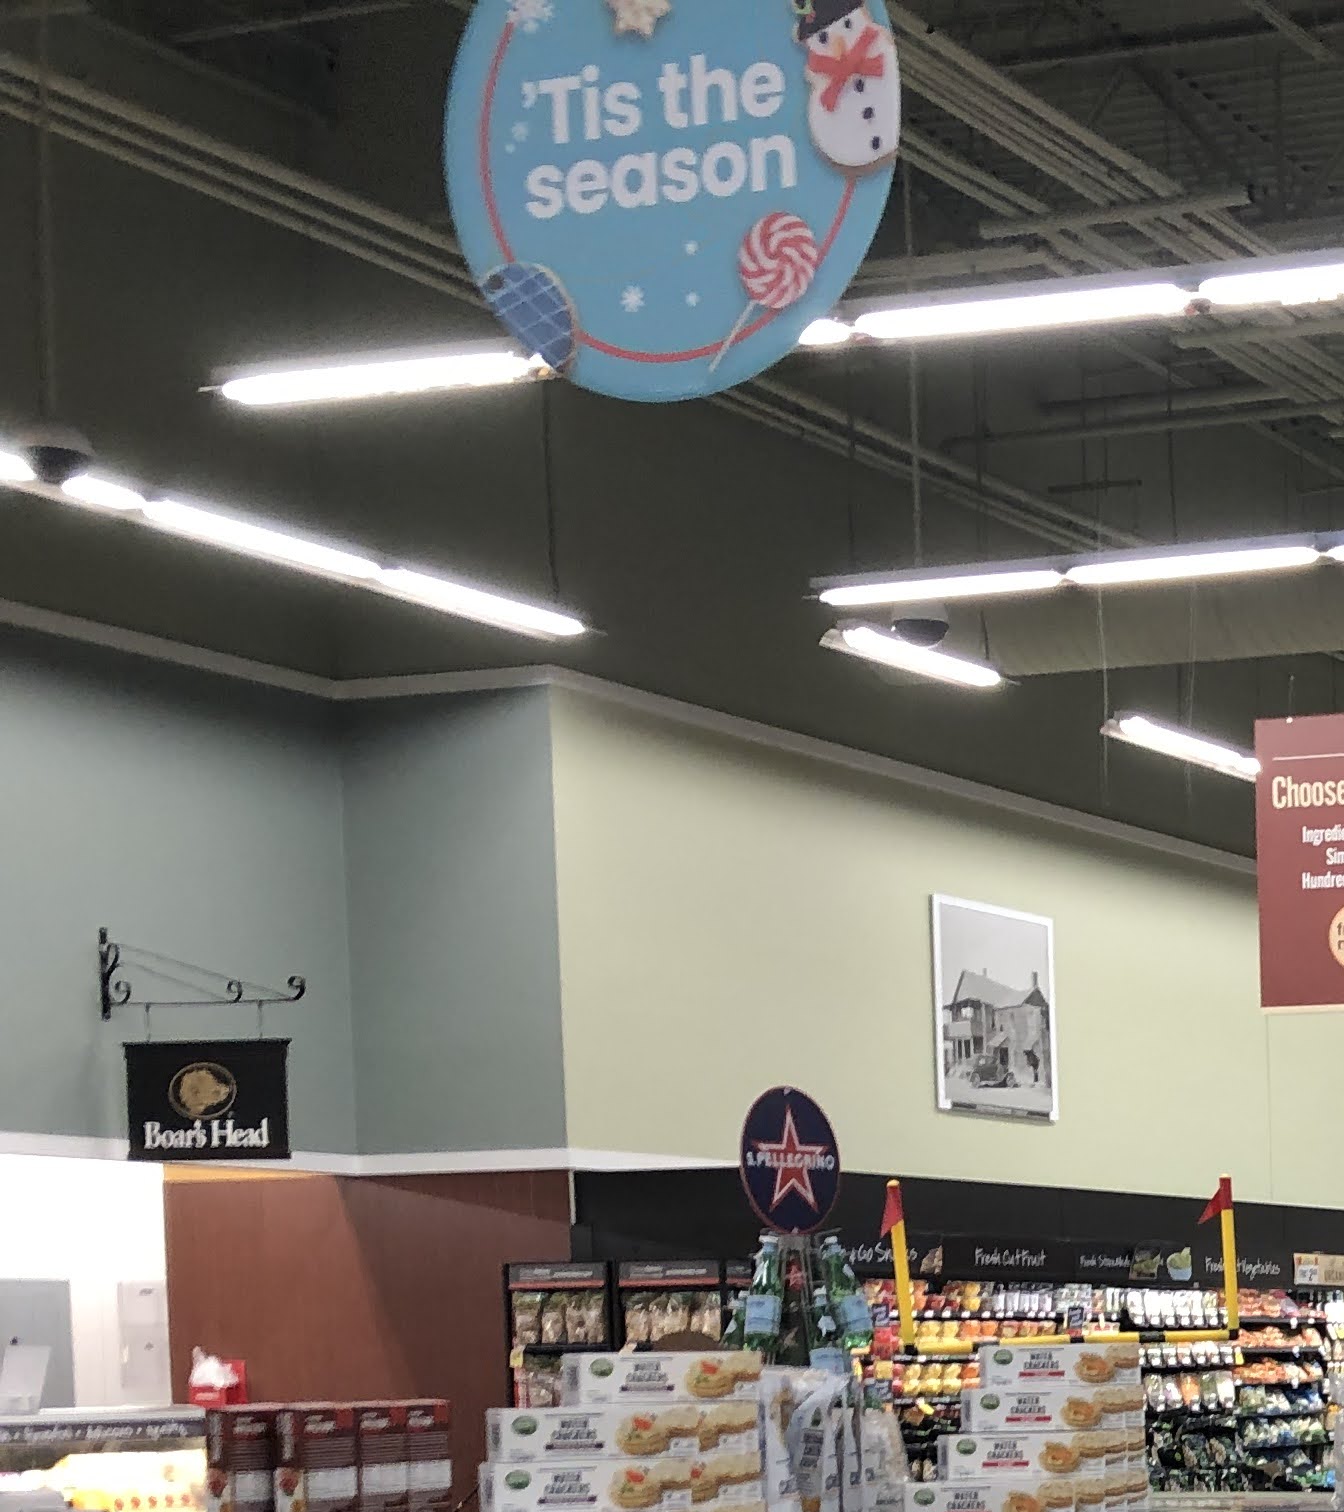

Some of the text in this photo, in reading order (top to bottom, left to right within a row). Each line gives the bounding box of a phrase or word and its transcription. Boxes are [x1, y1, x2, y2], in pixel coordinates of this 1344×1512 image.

[522, 54, 785, 144] 'Tis the
[525, 133, 796, 219] season
[144, 1117, 270, 1149] Boar's Head
[974, 1247, 1000, 1266] Fresh
